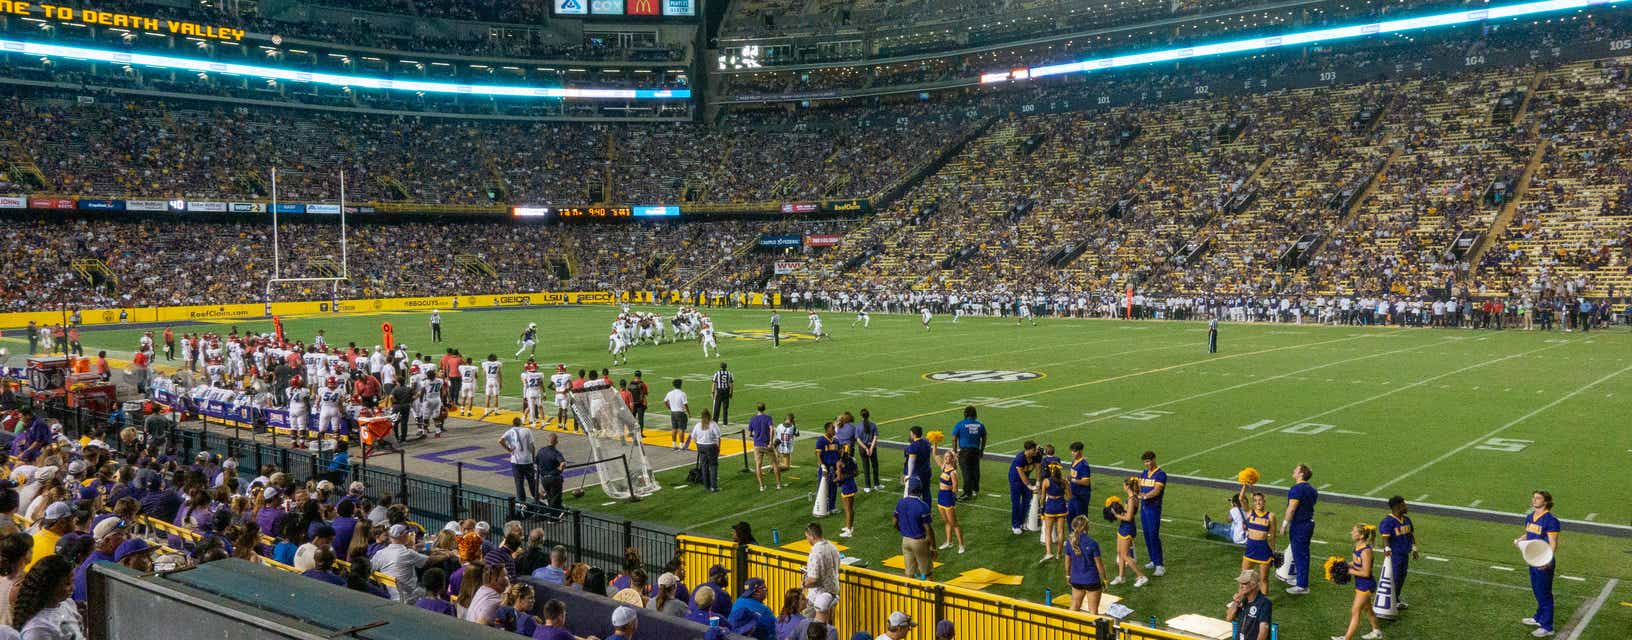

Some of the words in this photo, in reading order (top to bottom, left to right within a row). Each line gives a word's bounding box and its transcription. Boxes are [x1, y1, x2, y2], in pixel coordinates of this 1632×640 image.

[41, 4, 73, 20] TO
[83, 10, 159, 31] DEATH
[167, 20, 245, 41] VALLEY
[1609, 39, 1632, 51] 105
[1464, 56, 1486, 66] 104
[1319, 71, 1337, 81] 103
[1194, 86, 1209, 95] 102
[1097, 96, 1110, 105] 101
[169, 200, 184, 210] 40
[501, 296, 530, 304] GEICO
[322, 391, 339, 402] 54
[1474, 437, 1536, 452] 5
[1375, 566, 1393, 609] LSU
